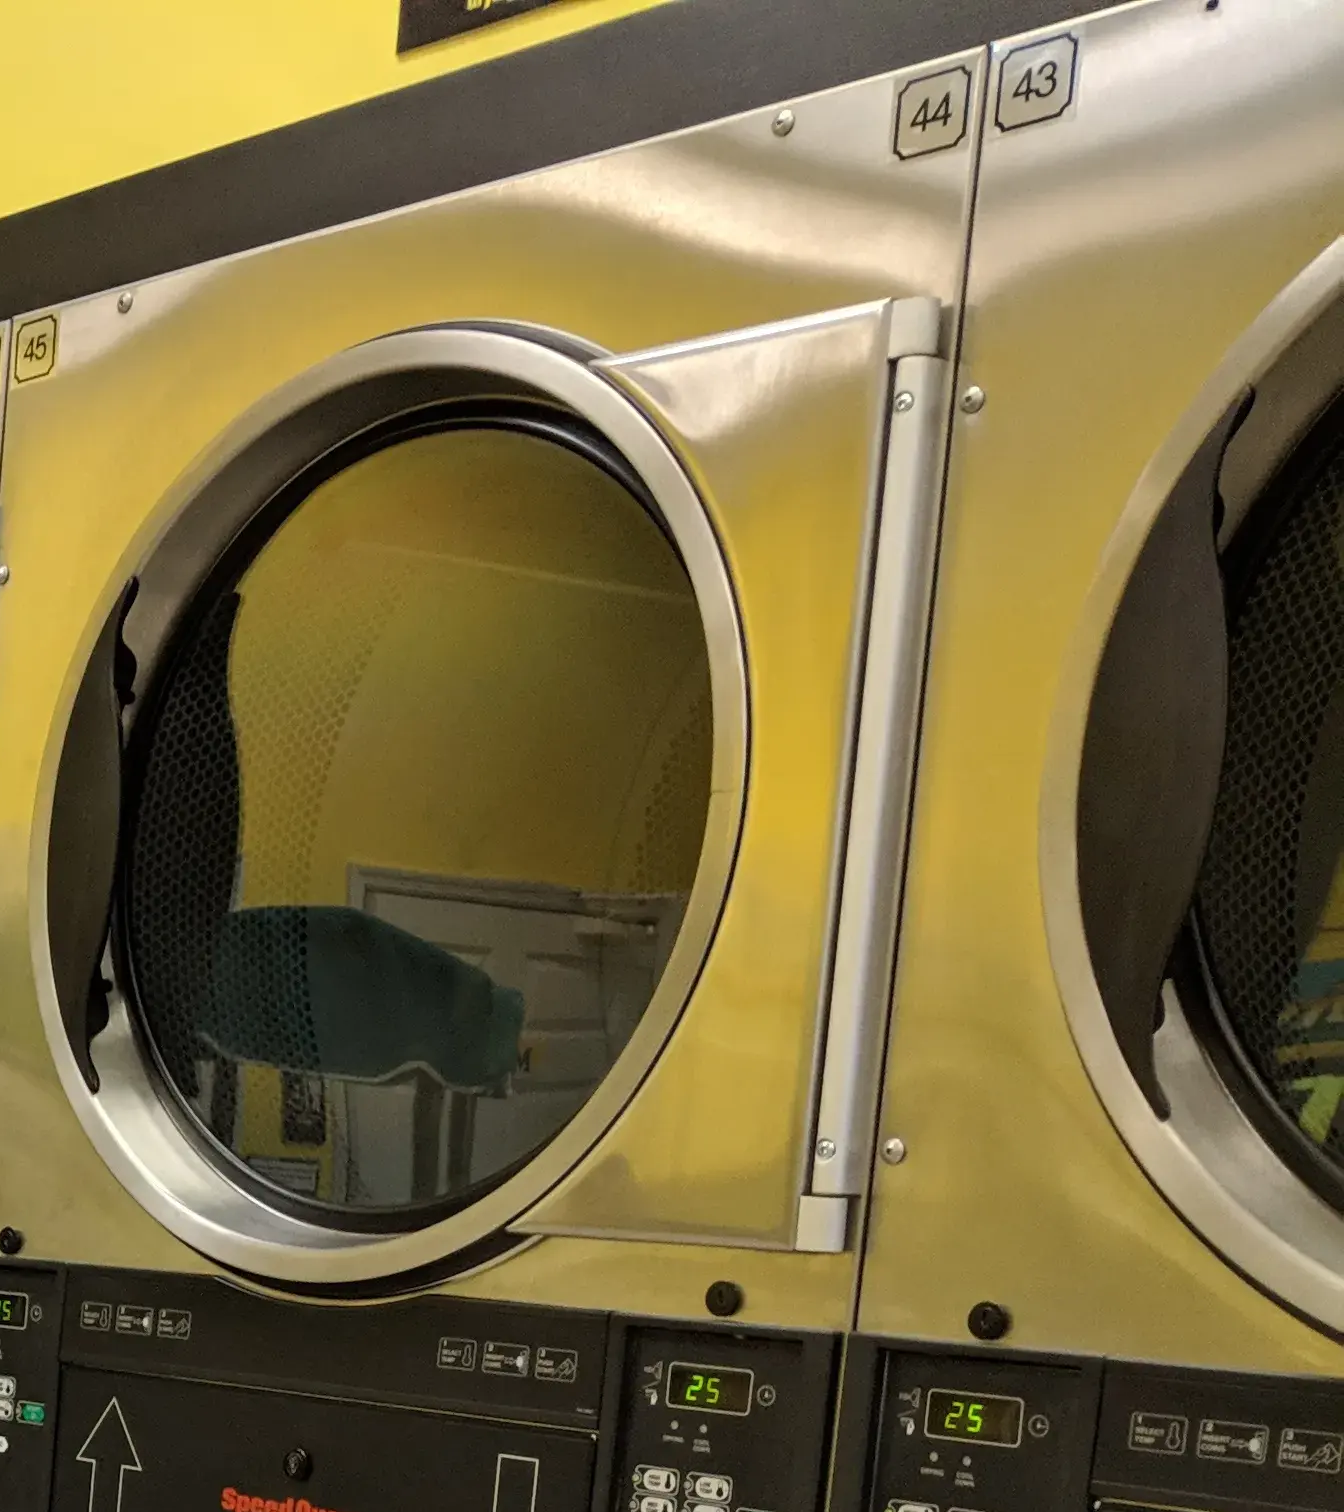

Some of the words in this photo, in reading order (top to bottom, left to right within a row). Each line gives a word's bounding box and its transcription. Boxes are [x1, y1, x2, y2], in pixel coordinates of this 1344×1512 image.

[1012, 61, 1059, 104] 43
[910, 92, 953, 132] 44
[23, 333, 47, 362] 45
[685, 1375, 721, 1404] 25
[944, 1401, 984, 1433] 25
